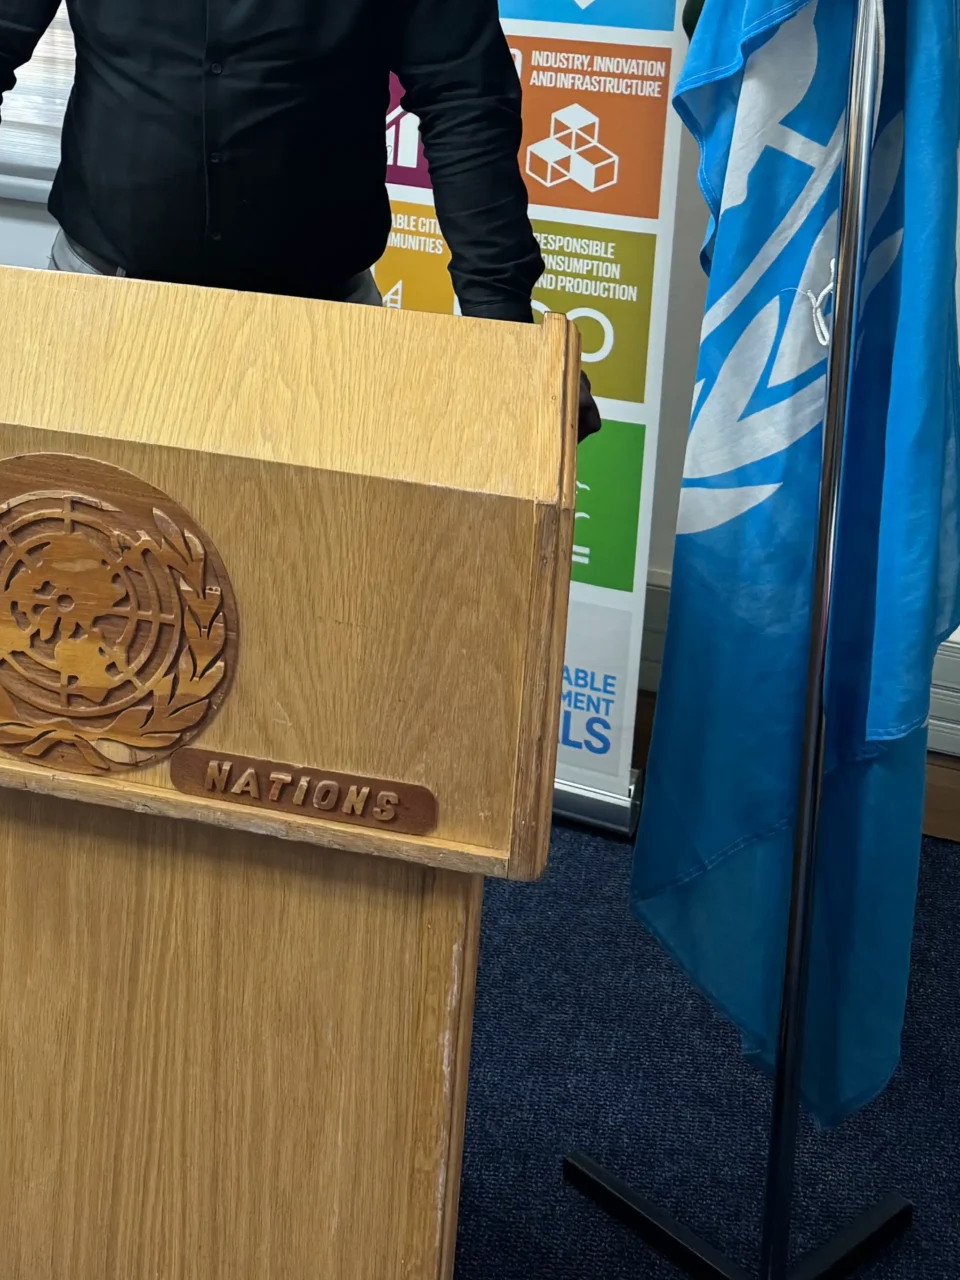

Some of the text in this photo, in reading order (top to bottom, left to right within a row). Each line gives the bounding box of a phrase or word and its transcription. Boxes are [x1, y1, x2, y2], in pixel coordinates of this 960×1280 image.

[531, 50, 591, 72] INDUSTRY,
[593, 55, 666, 77] INNOVATION
[530, 70, 662, 97] AND INFRASTRUCTURE
[388, 231, 443, 255] MUNITIES
[557, 275, 638, 302] PRODUCTION
[204, 760, 400, 821] NATIONS
